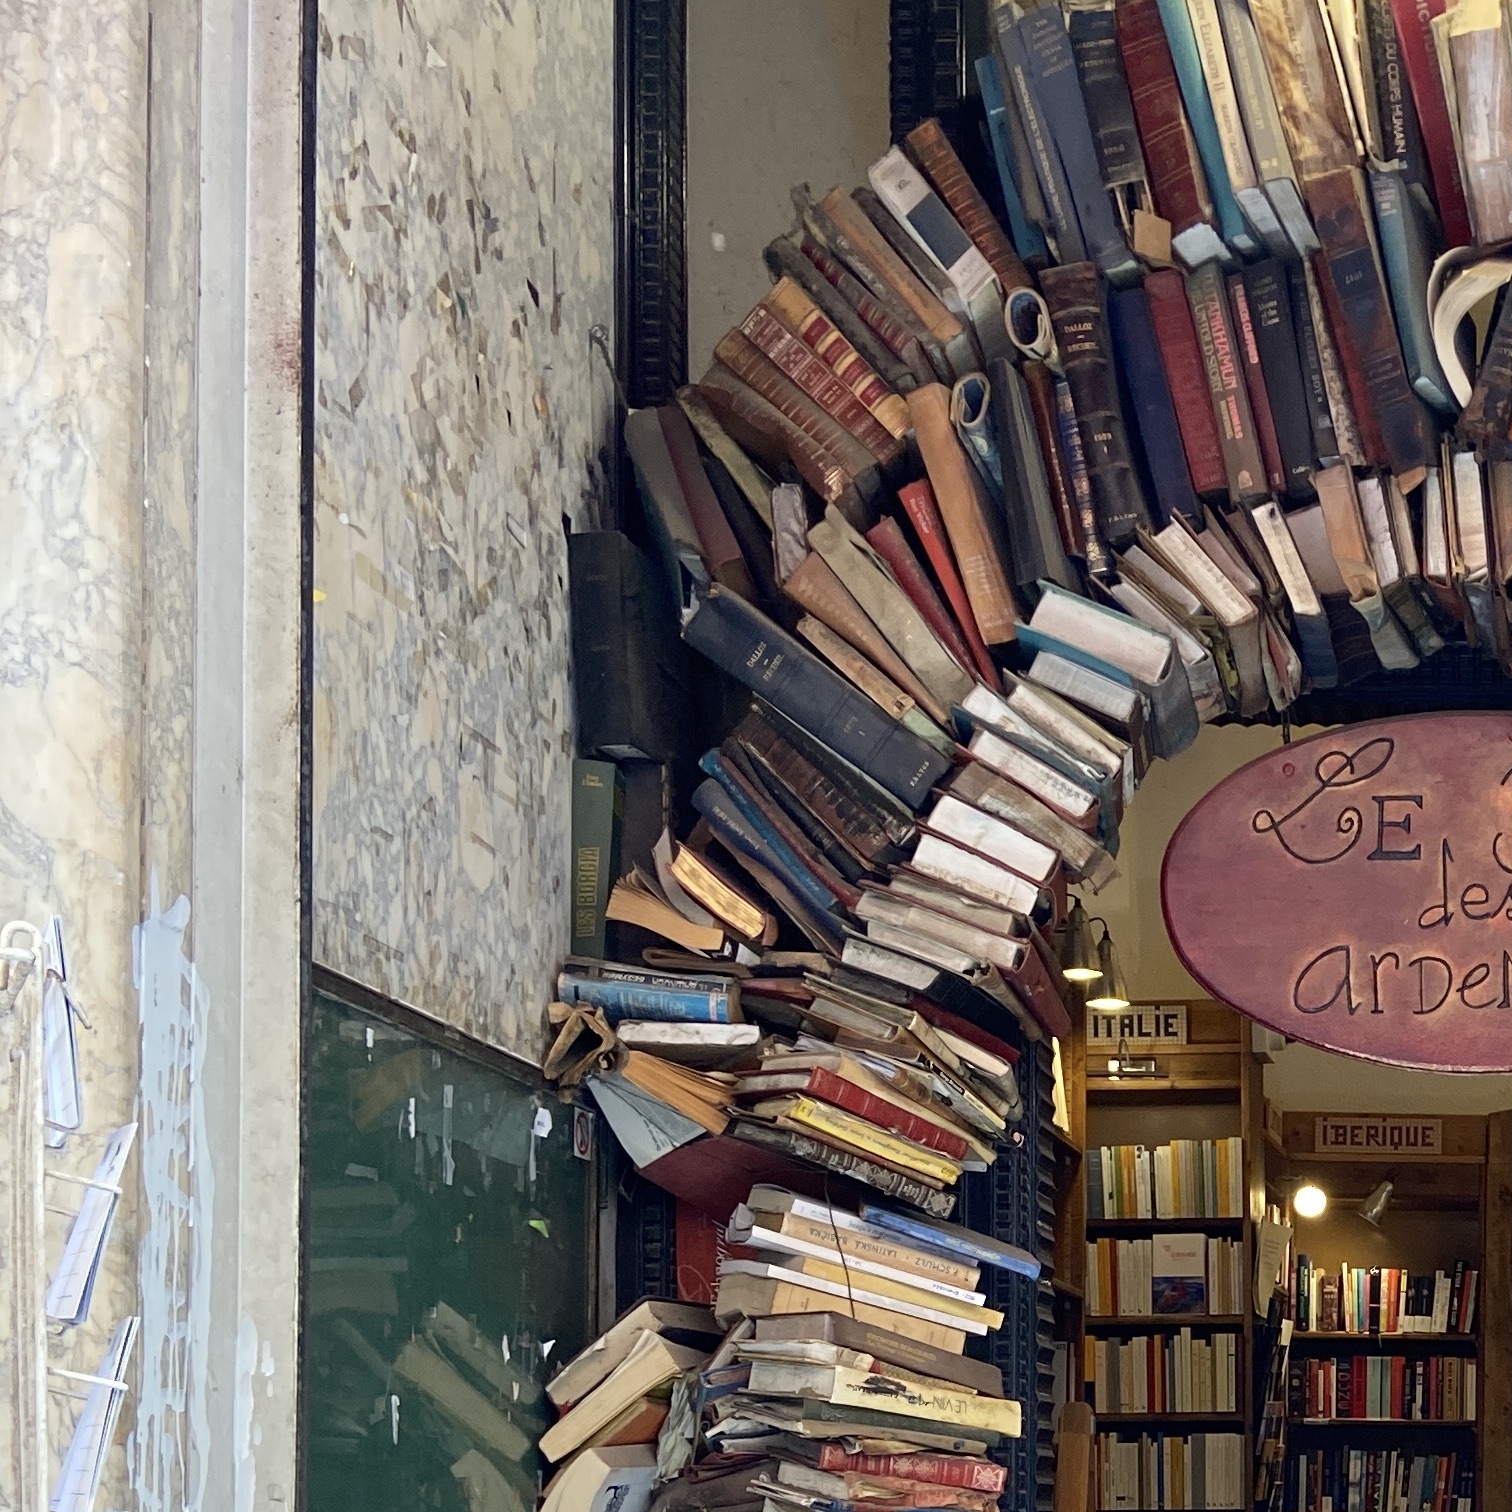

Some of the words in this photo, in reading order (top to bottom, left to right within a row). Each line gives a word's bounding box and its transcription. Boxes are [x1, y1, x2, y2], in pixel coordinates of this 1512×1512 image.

[1385, 42, 1397, 60] DU
[1390, 104, 1407, 153] HUMAIN
[1199, 274, 1238, 391] TUTANKHAMUN
[1252, 737, 1424, 864] LE
[578, 846, 600, 906] BORGIA
[576, 909, 597, 938] LES
[1092, 1006, 1179, 1038] ITALIE
[914, 1256, 952, 1275] SCHULZ
